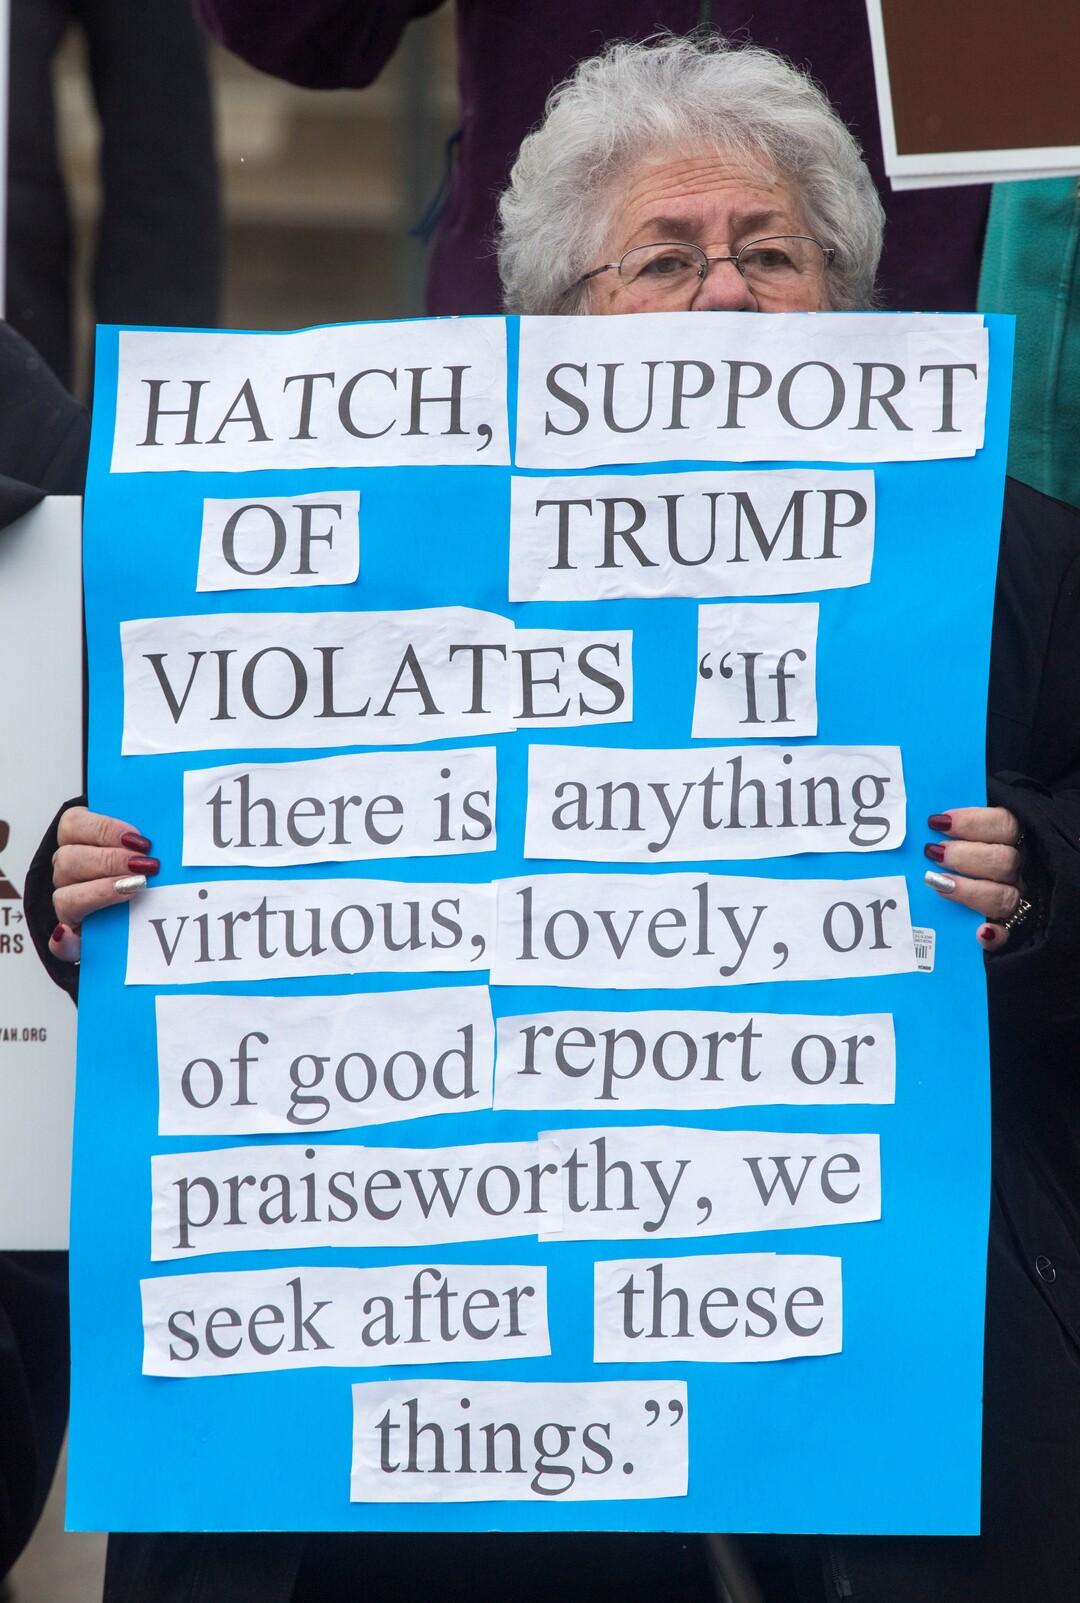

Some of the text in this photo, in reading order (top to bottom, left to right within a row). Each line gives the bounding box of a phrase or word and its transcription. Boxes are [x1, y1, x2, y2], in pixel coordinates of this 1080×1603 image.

[136, 360, 978, 452] HATCH, SUPPORT
[221, 489, 868, 576] OF TRUMP
[142, 642, 807, 724] VIOLATES “If
[206, 755, 891, 853] there is anything
[148, 885, 897, 977] virtuous, lovely, or
[181, 1018, 875, 1125] of good report or
[172, 1136, 860, 1249] praiseworthy, we
[167, 1263, 824, 1361] seek after these
[374, 1395, 684, 1496] things.”
